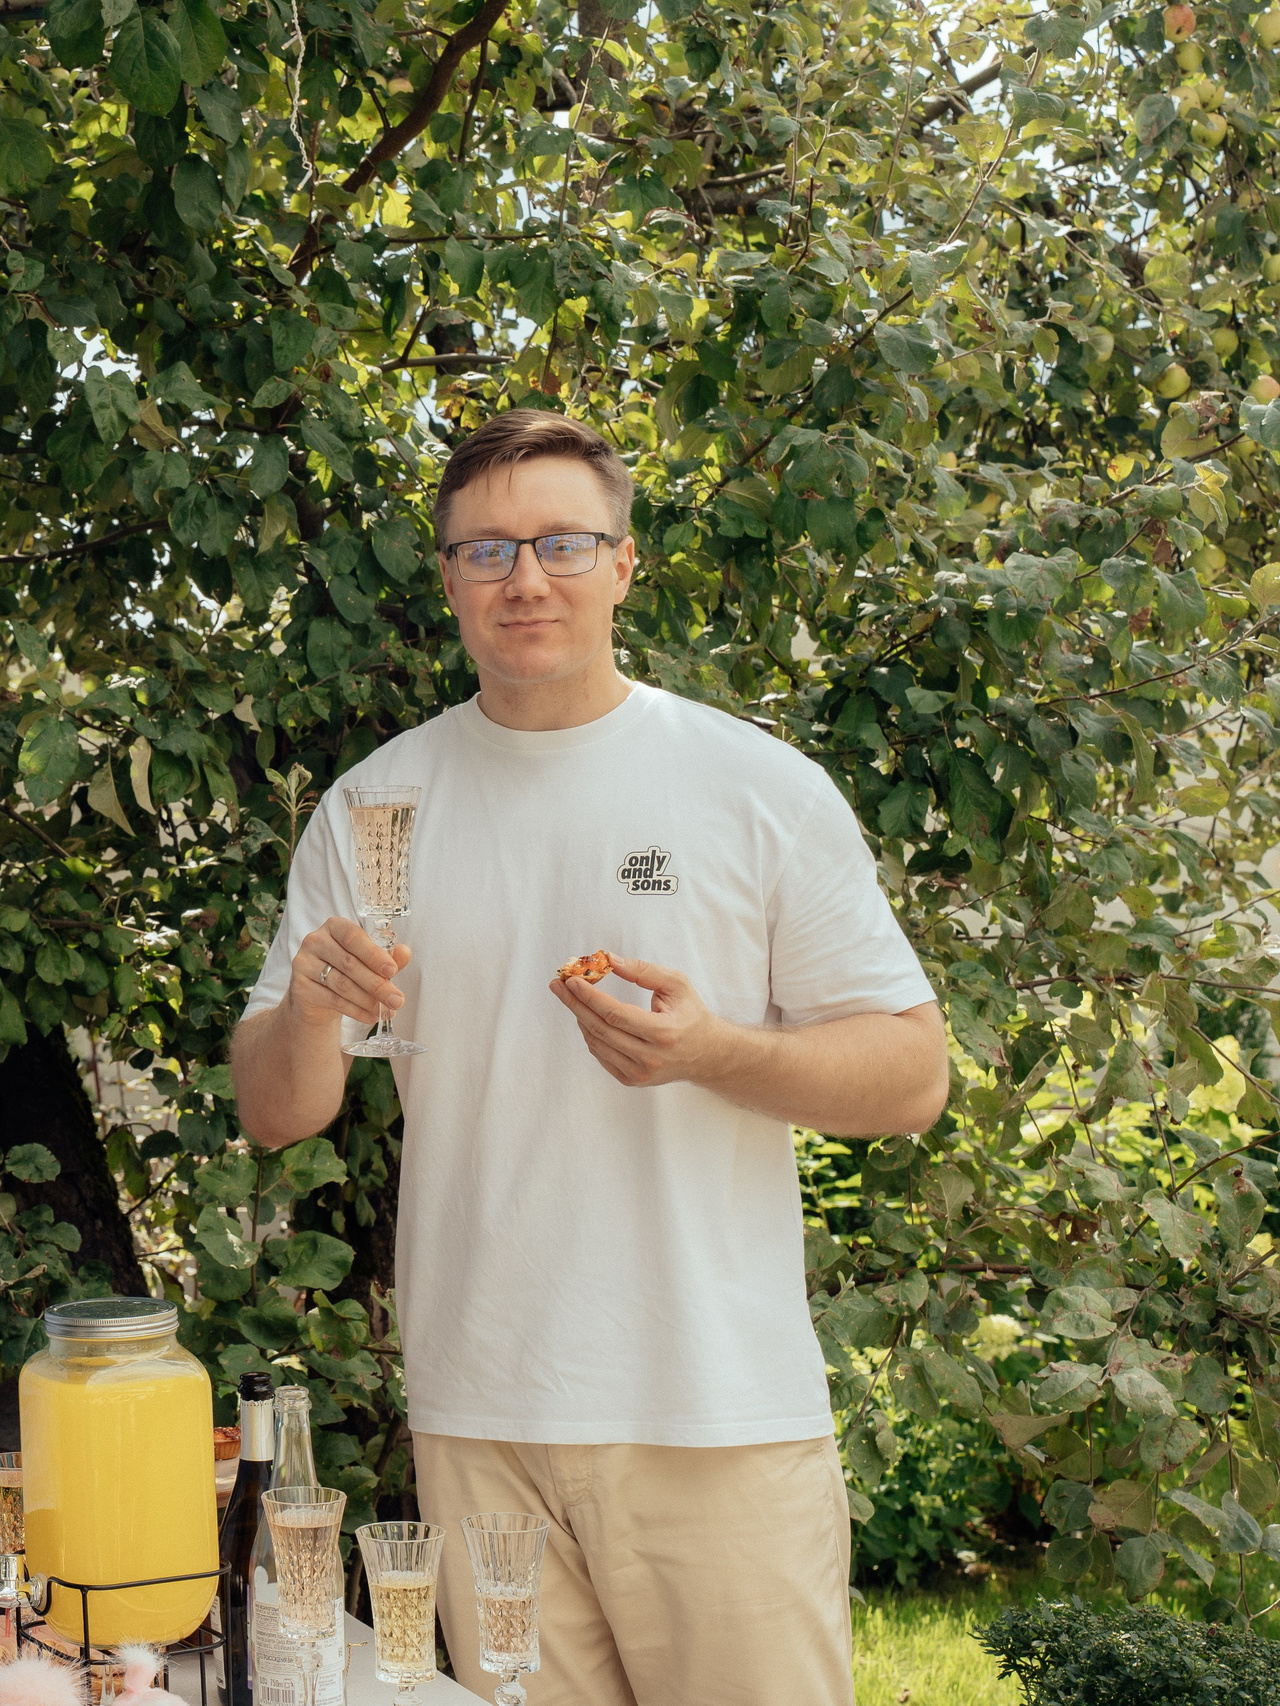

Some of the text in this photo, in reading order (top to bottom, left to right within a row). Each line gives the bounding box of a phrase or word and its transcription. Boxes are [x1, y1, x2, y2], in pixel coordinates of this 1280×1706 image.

[628, 850, 667, 871] only
[621, 864, 654, 879] and
[631, 879, 671, 891] sons
